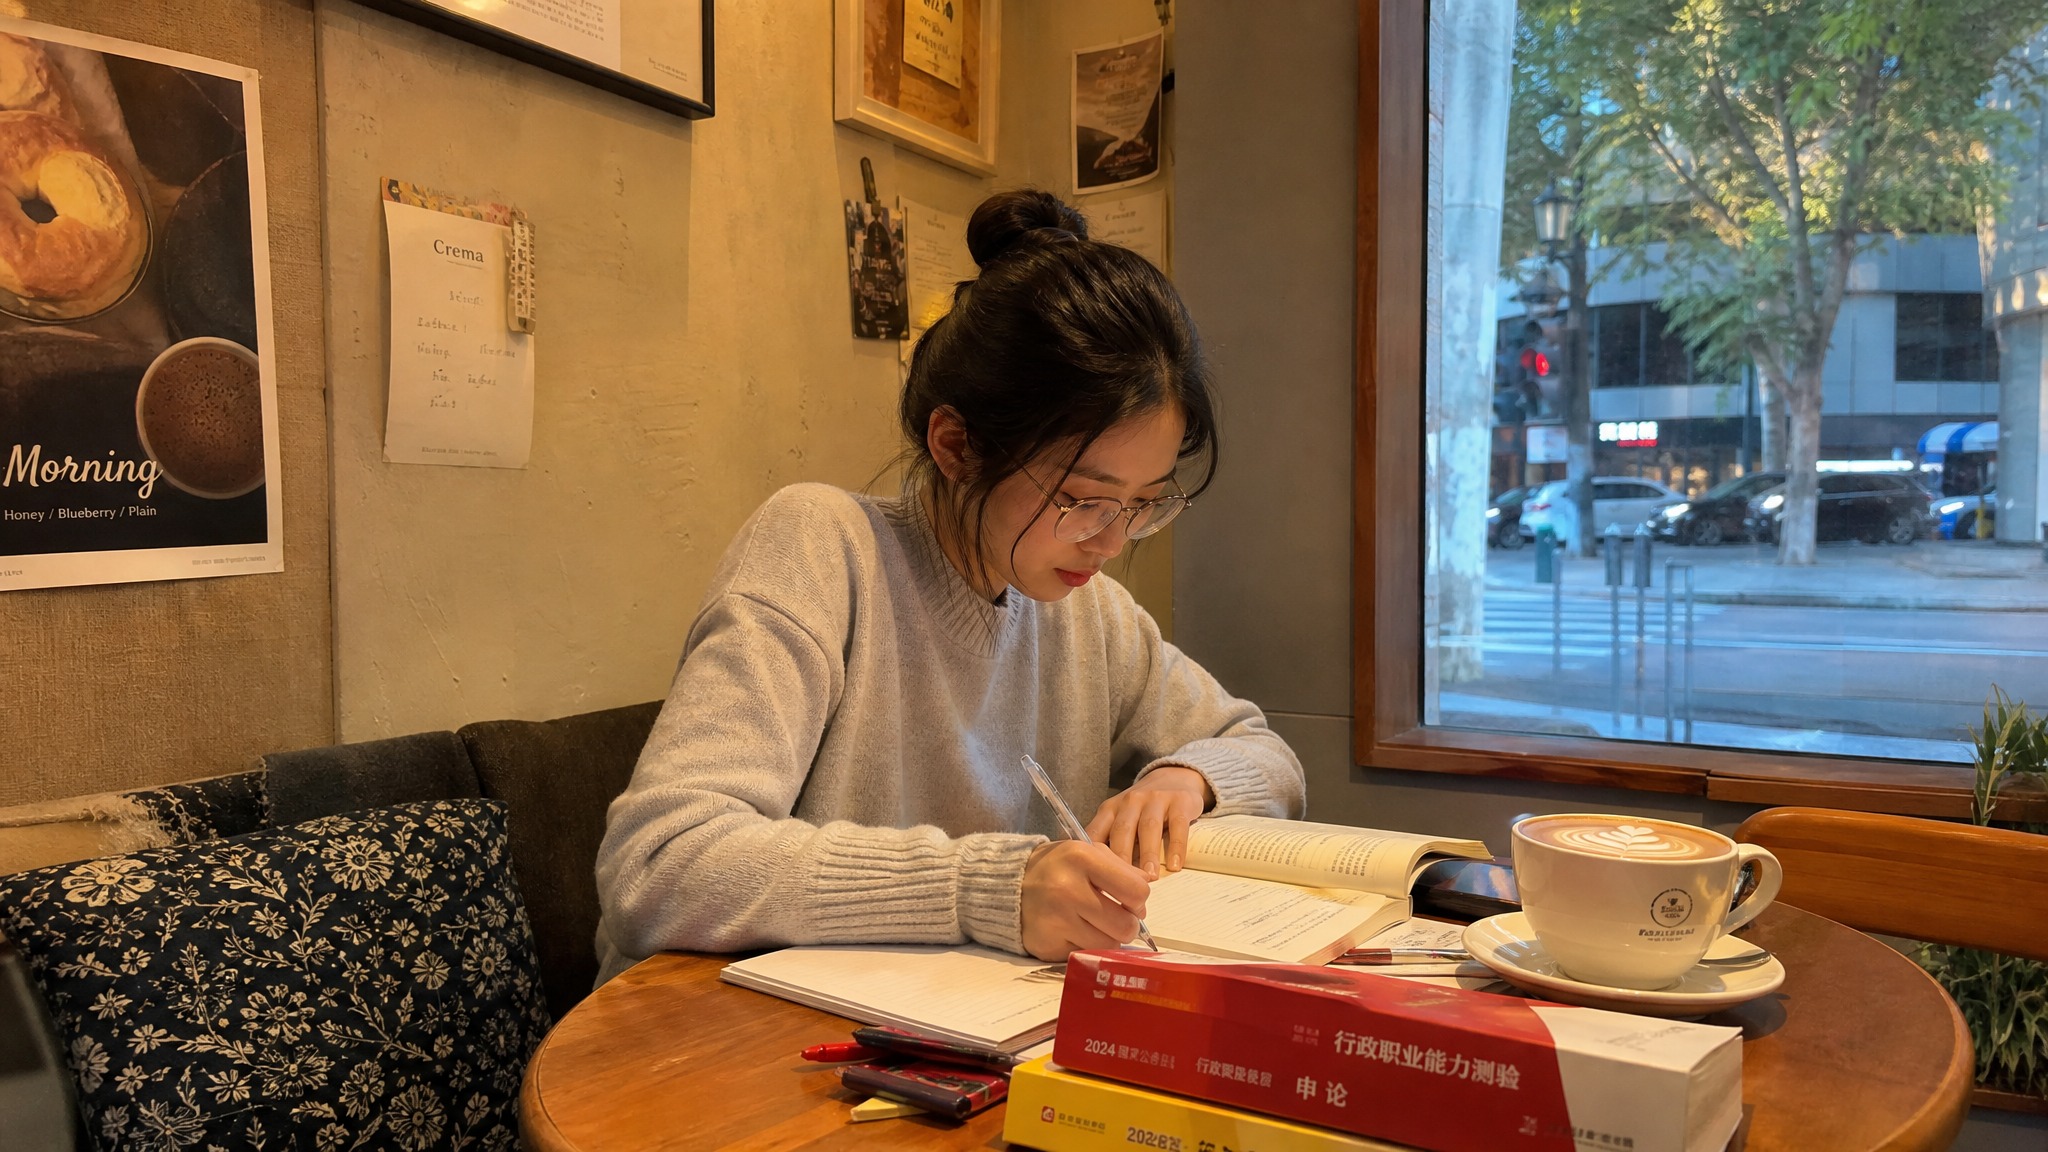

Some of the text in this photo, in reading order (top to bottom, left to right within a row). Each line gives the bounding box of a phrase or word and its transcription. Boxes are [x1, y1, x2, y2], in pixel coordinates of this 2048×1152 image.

[433, 239, 485, 263] Crema
[2, 444, 164, 499] Morning
[4, 509, 45, 523] Honey
[58, 507, 117, 520] Blueberry
[129, 505, 157, 517] Plain
[1084, 1038, 1116, 1057] 2024
[1334, 1030, 1521, 1090] 行政职业能力测验
[1296, 1076, 1348, 1108] 申论
